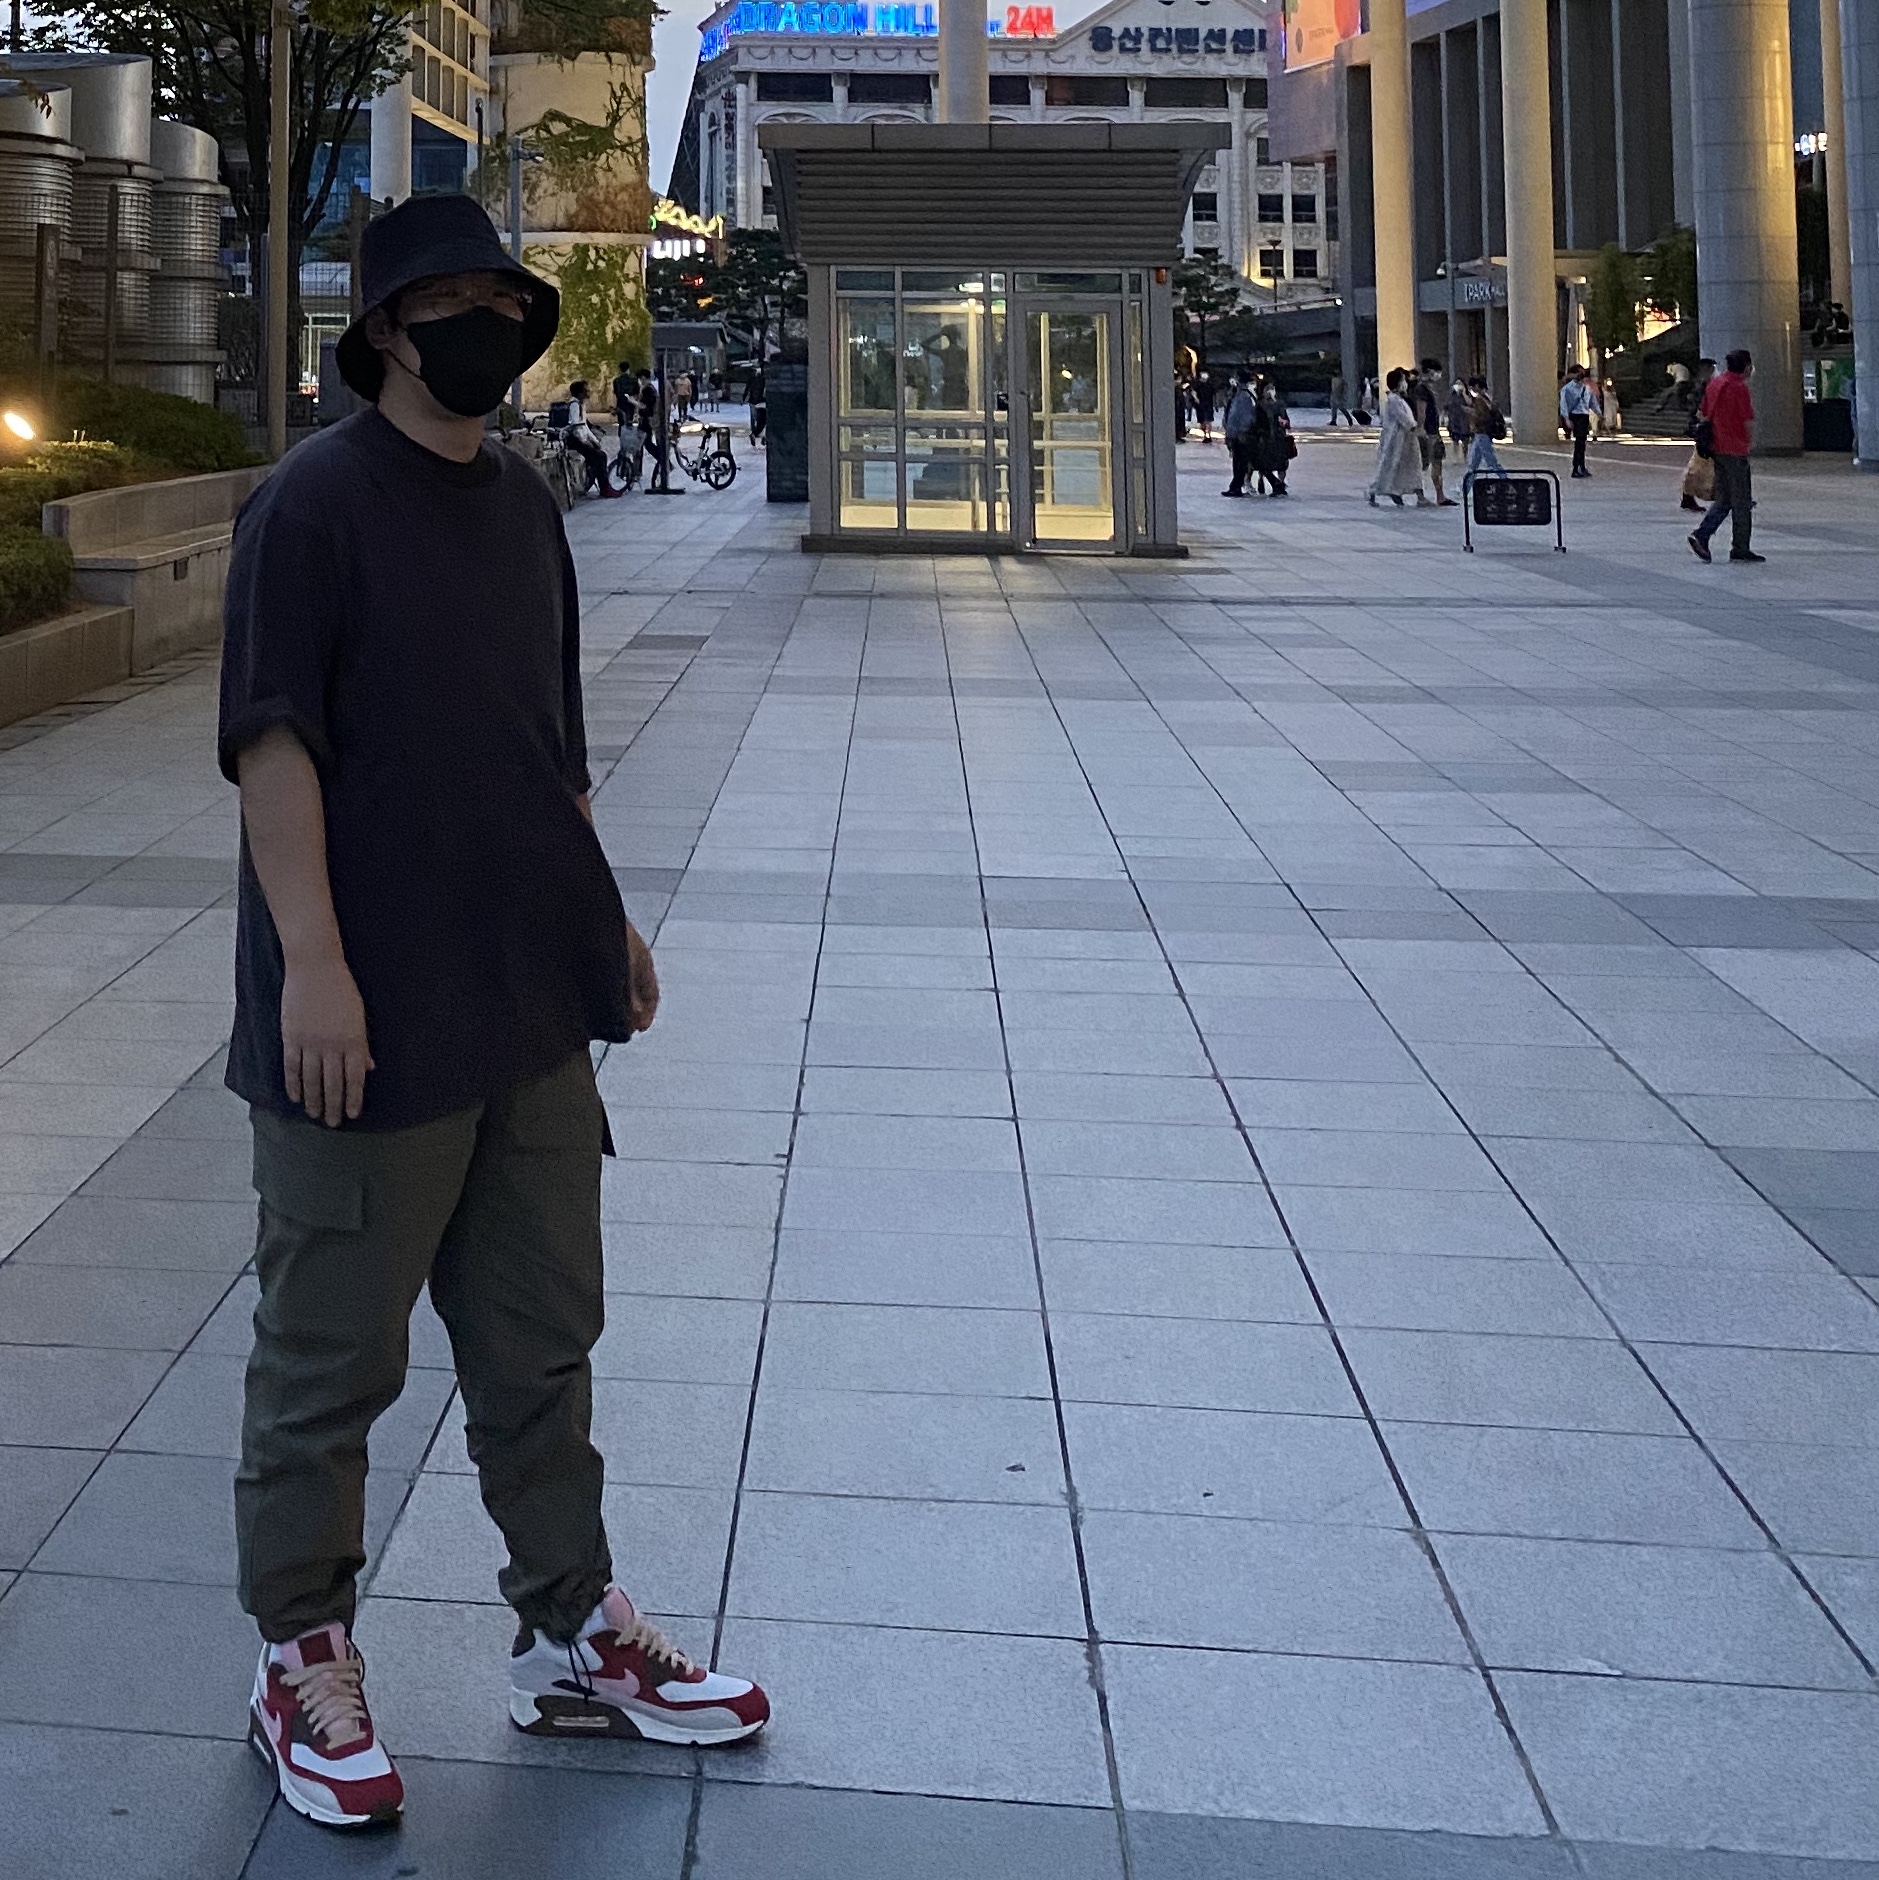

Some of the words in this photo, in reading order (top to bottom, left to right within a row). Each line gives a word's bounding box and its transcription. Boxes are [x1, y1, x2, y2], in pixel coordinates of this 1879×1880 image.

[739, 1, 868, 33] DRAGON
[876, 3, 938, 36] HILL
[1006, 5, 1053, 35] 24H
